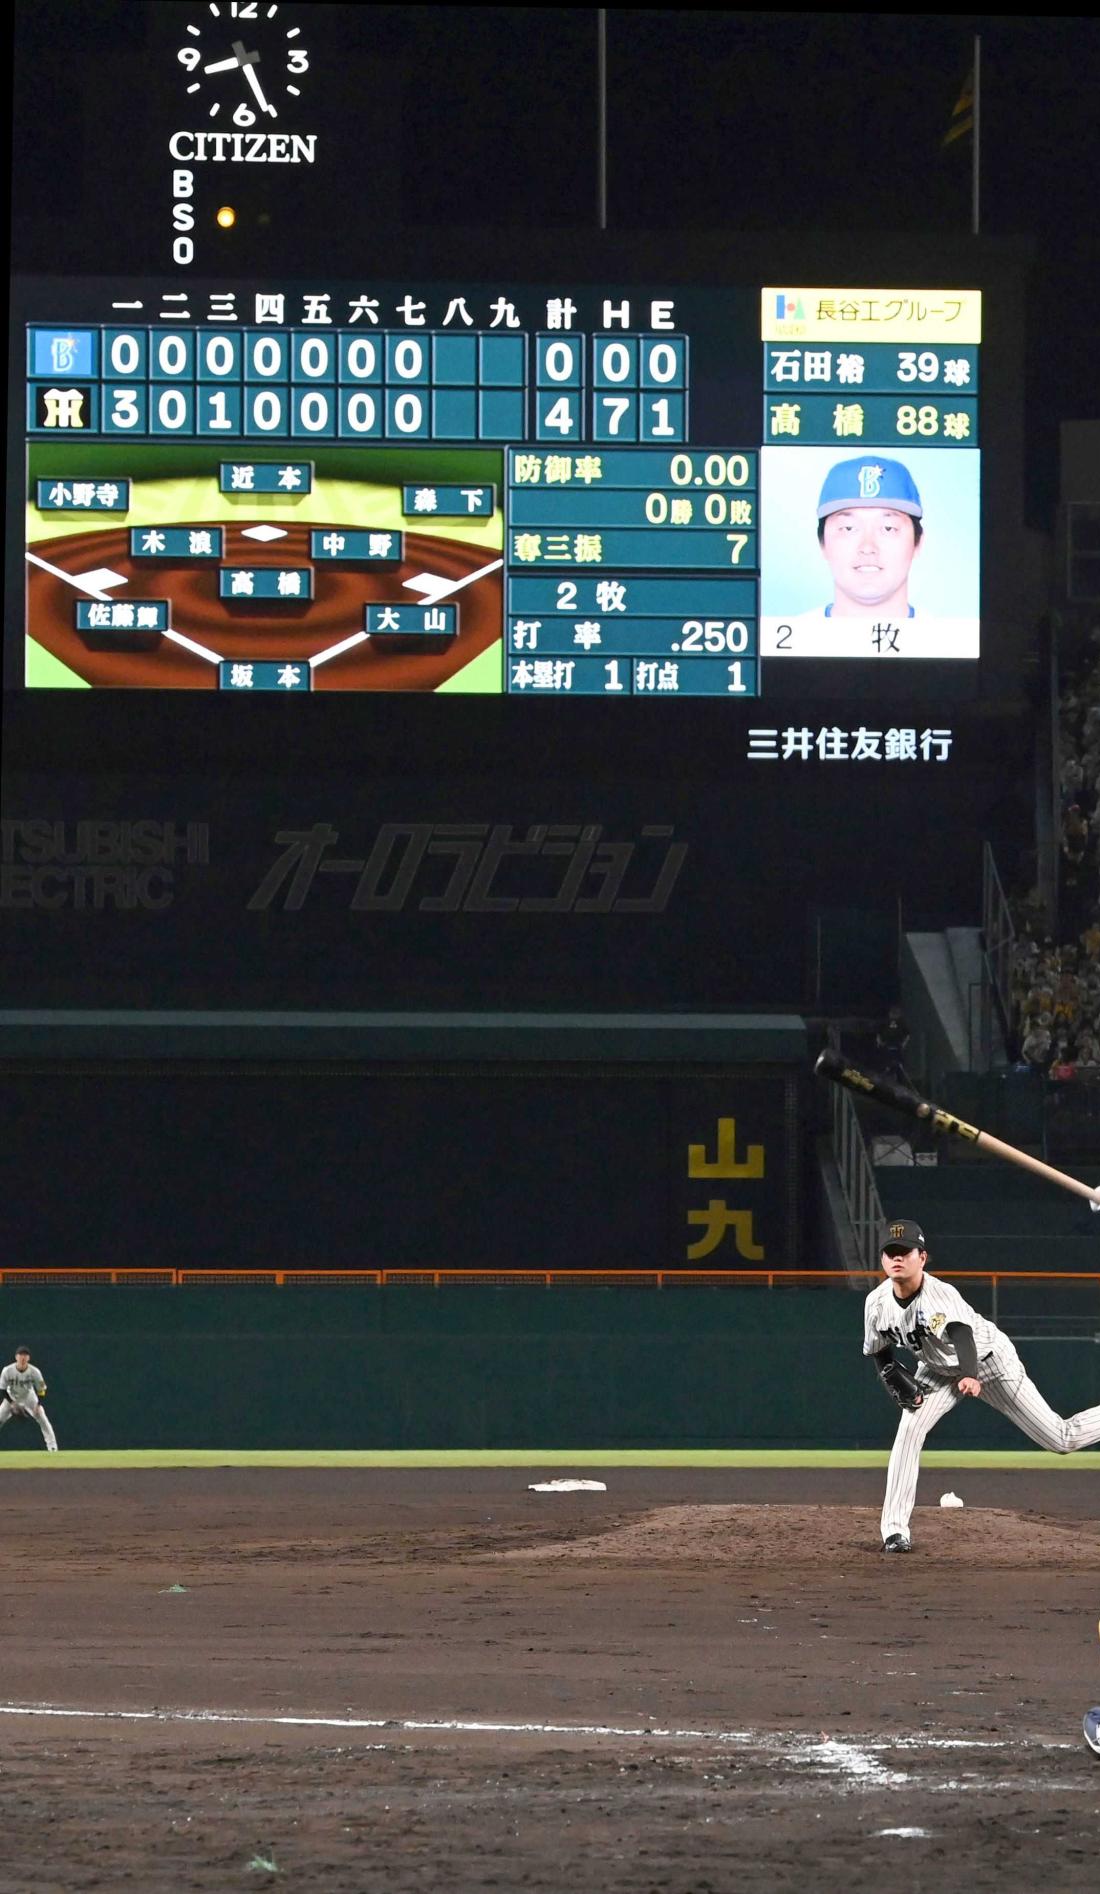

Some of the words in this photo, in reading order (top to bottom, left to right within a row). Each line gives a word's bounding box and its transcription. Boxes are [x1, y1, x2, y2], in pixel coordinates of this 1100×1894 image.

[177, 47, 201, 72] 9
[286, 50, 309, 74] 3
[232, 103, 256, 127] 6
[169, 131, 318, 163] CITIZEN
[173, 169, 194, 198] B
[172, 203, 195, 231] S
[112, 300, 143, 309] 一
[159, 293, 191, 319] 二
[207, 292, 238, 321] 三
[255, 293, 285, 324] 四
[301, 293, 333, 324] 五
[348, 294, 380, 324] 六
[395, 295, 426, 326] 七
[442, 297, 474, 326] 八
[489, 296, 521, 328] 九
[546, 297, 577, 330] 計
[603, 300, 630, 329] H
[651, 300, 675, 330] E
[815, 299, 964, 323] 長谷工グループ
[111, 334, 139, 374] 0
[158, 335, 187, 375] 0
[206, 336, 234, 376] 0
[253, 337, 281, 377] 0
[300, 338, 328, 377] 0
[347, 338, 376, 378] 0
[394, 339, 423, 379] 0
[545, 342, 573, 381] 0
[602, 343, 630, 382] 0
[649, 343, 677, 383] 0
[770, 349, 865, 384] 石田裕
[896, 351, 971, 387] 39球
[111, 389, 139, 428] 3
[158, 389, 187, 429] 0
[209, 391, 232, 429] 1
[253, 391, 281, 431] 0
[300, 392, 328, 431] 0
[347, 392, 375, 432] 0
[394, 393, 422, 433] 0
[544, 397, 574, 435] 4
[602, 397, 630, 435] 7
[651, 398, 674, 436] 1
[896, 405, 970, 440] 88球
[231, 465, 301, 489] 近本
[514, 454, 602, 484] 防御率
[670, 454, 749, 487] 0.00
[49, 482, 119, 507] 小野寺
[414, 488, 483, 513] 森下
[645, 492, 693, 525] 0勝
[704, 493, 752, 525] 0敗
[142, 530, 212, 554] 木浪
[323, 532, 392, 557] 中野
[514, 533, 602, 563] 奪三振
[726, 533, 748, 564] 7
[556, 581, 577, 610] 2
[596, 580, 627, 612] 牧
[87, 603, 158, 628] 佐藤輝
[377, 607, 446, 631] 大山
[513, 620, 602, 650] 打率
[671, 620, 748, 653] .250
[776, 625, 792, 649] 2
[872, 623, 900, 653] 牧
[230, 664, 301, 688] 坂本
[511, 660, 576, 690] 本塁打
[604, 659, 623, 690] 1
[636, 661, 679, 690] 打点
[727, 661, 746, 692] 1
[746, 726, 953, 761] 三井住友銀行
[687, 1117, 765, 1261] 山九
